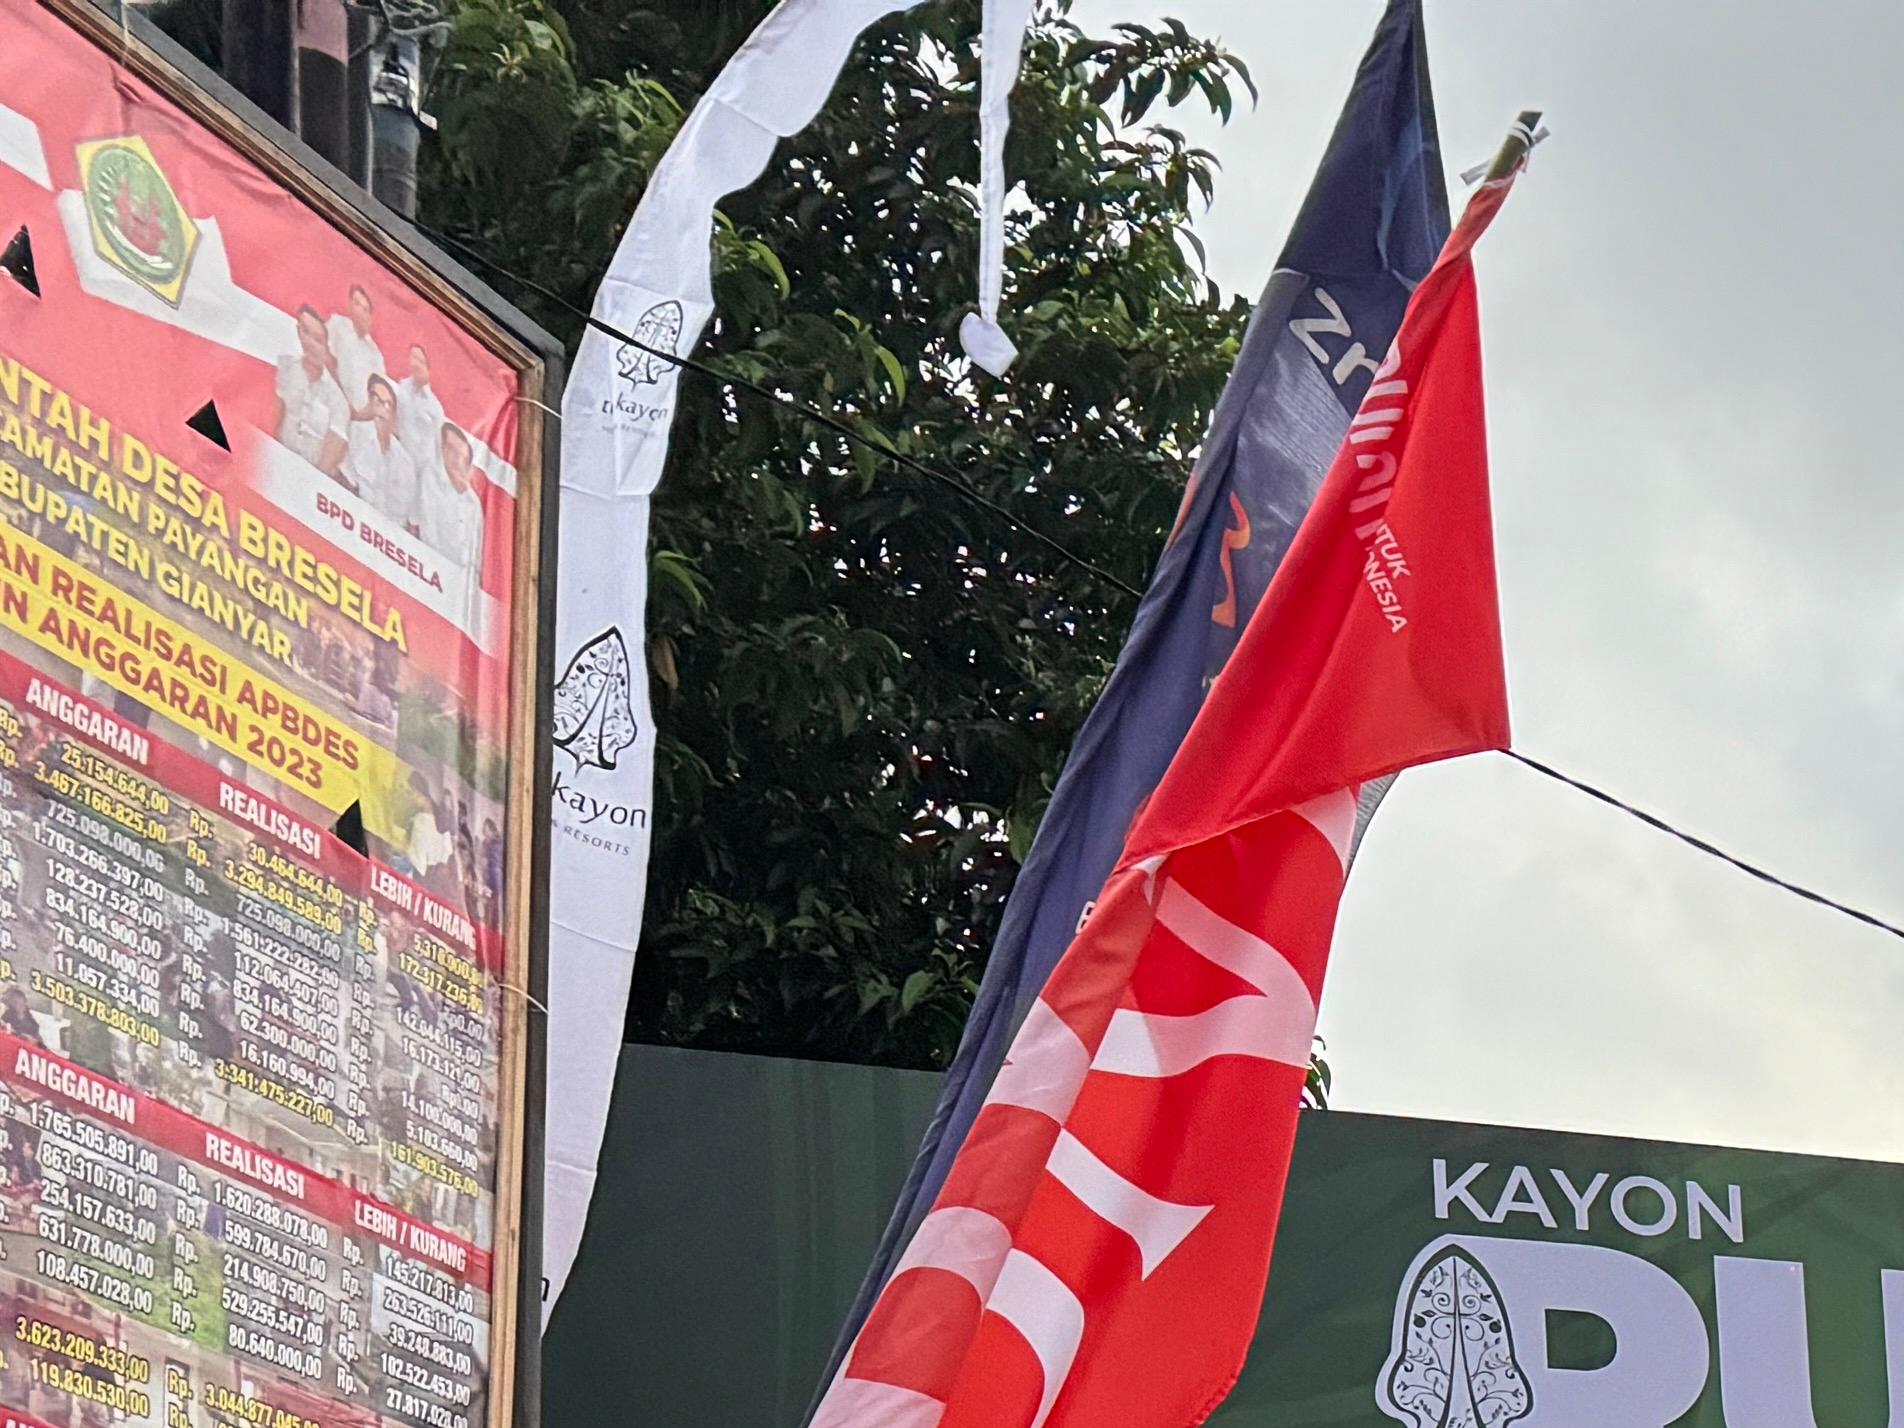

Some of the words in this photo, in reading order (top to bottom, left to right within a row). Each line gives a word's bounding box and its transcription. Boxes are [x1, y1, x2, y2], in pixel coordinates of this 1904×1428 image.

[0, 410, 140, 523] AMATAN
[147, 503, 309, 629] PAYANGAN
[122, 432, 231, 540] DESA
[240, 509, 408, 653] BRESELA
[156, 561, 293, 667] GIANYAR
[316, 492, 354, 531] BPD
[360, 521, 443, 593] BRESELA
[38, 608, 238, 743] ANGGARAN
[247, 723, 323, 790] 2023
[52, 564, 228, 695] REALISASI
[237, 678, 360, 771] APBDES
[26, 678, 149, 765] ANGGARAN
[219, 781, 321, 859] REALISASI
[370, 865, 412, 912] LEBIH
[551, 771, 647, 830] kayon
[15, 1048, 135, 1124] ANGGARAN
[205, 1132, 304, 1199] REALISASI
[355, 1200, 396, 1240] LEBIH
[410, 1224, 466, 1272] KURANG
[1433, 1158, 1744, 1243] KAYON
